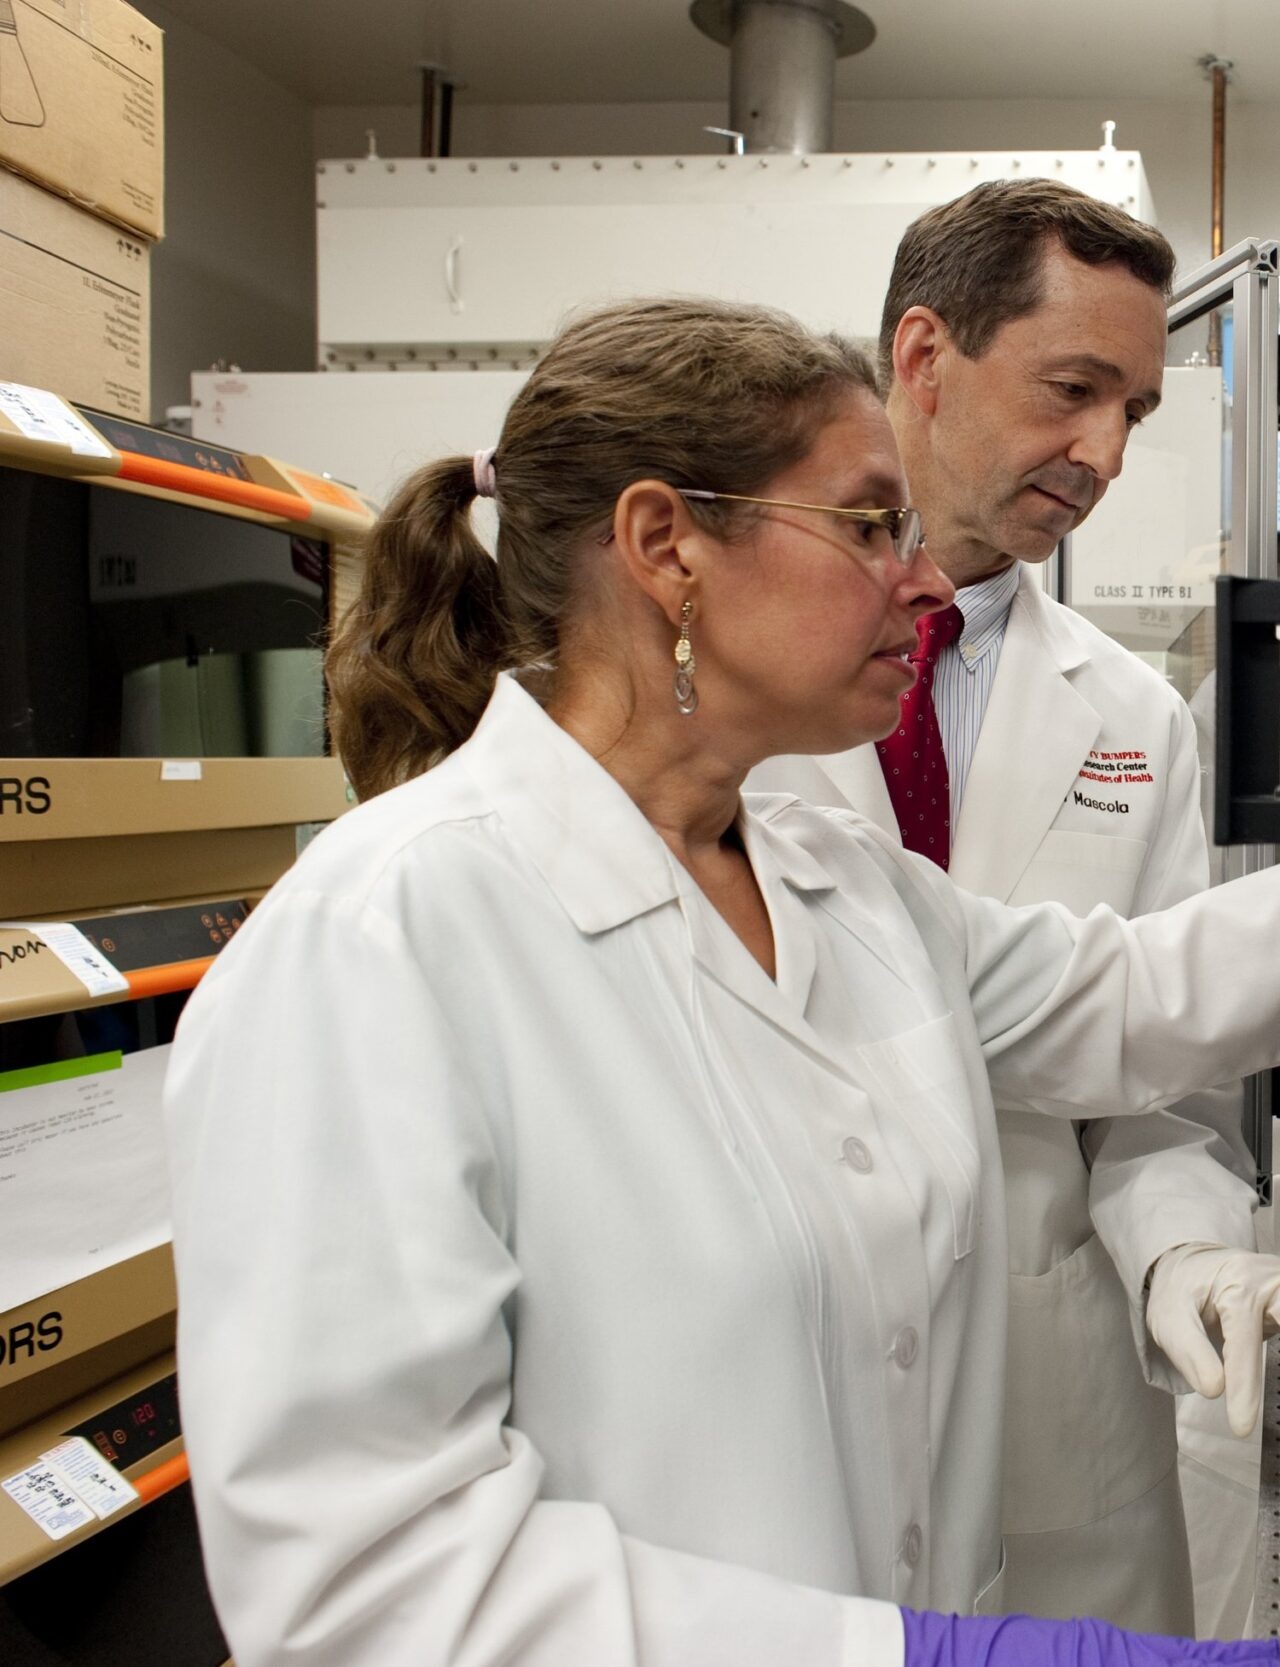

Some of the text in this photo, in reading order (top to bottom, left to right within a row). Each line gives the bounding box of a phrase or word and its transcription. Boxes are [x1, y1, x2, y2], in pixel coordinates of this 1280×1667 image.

[1094, 585, 1126, 598] CLASS
[1148, 586, 1174, 598] TYPE
[1100, 751, 1146, 760] BUMPERS
[1116, 762, 1147, 771] Center
[1114, 774, 1122, 783] of
[1124, 773, 1153, 782] Health
[1073, 790, 1129, 813] Mascola
